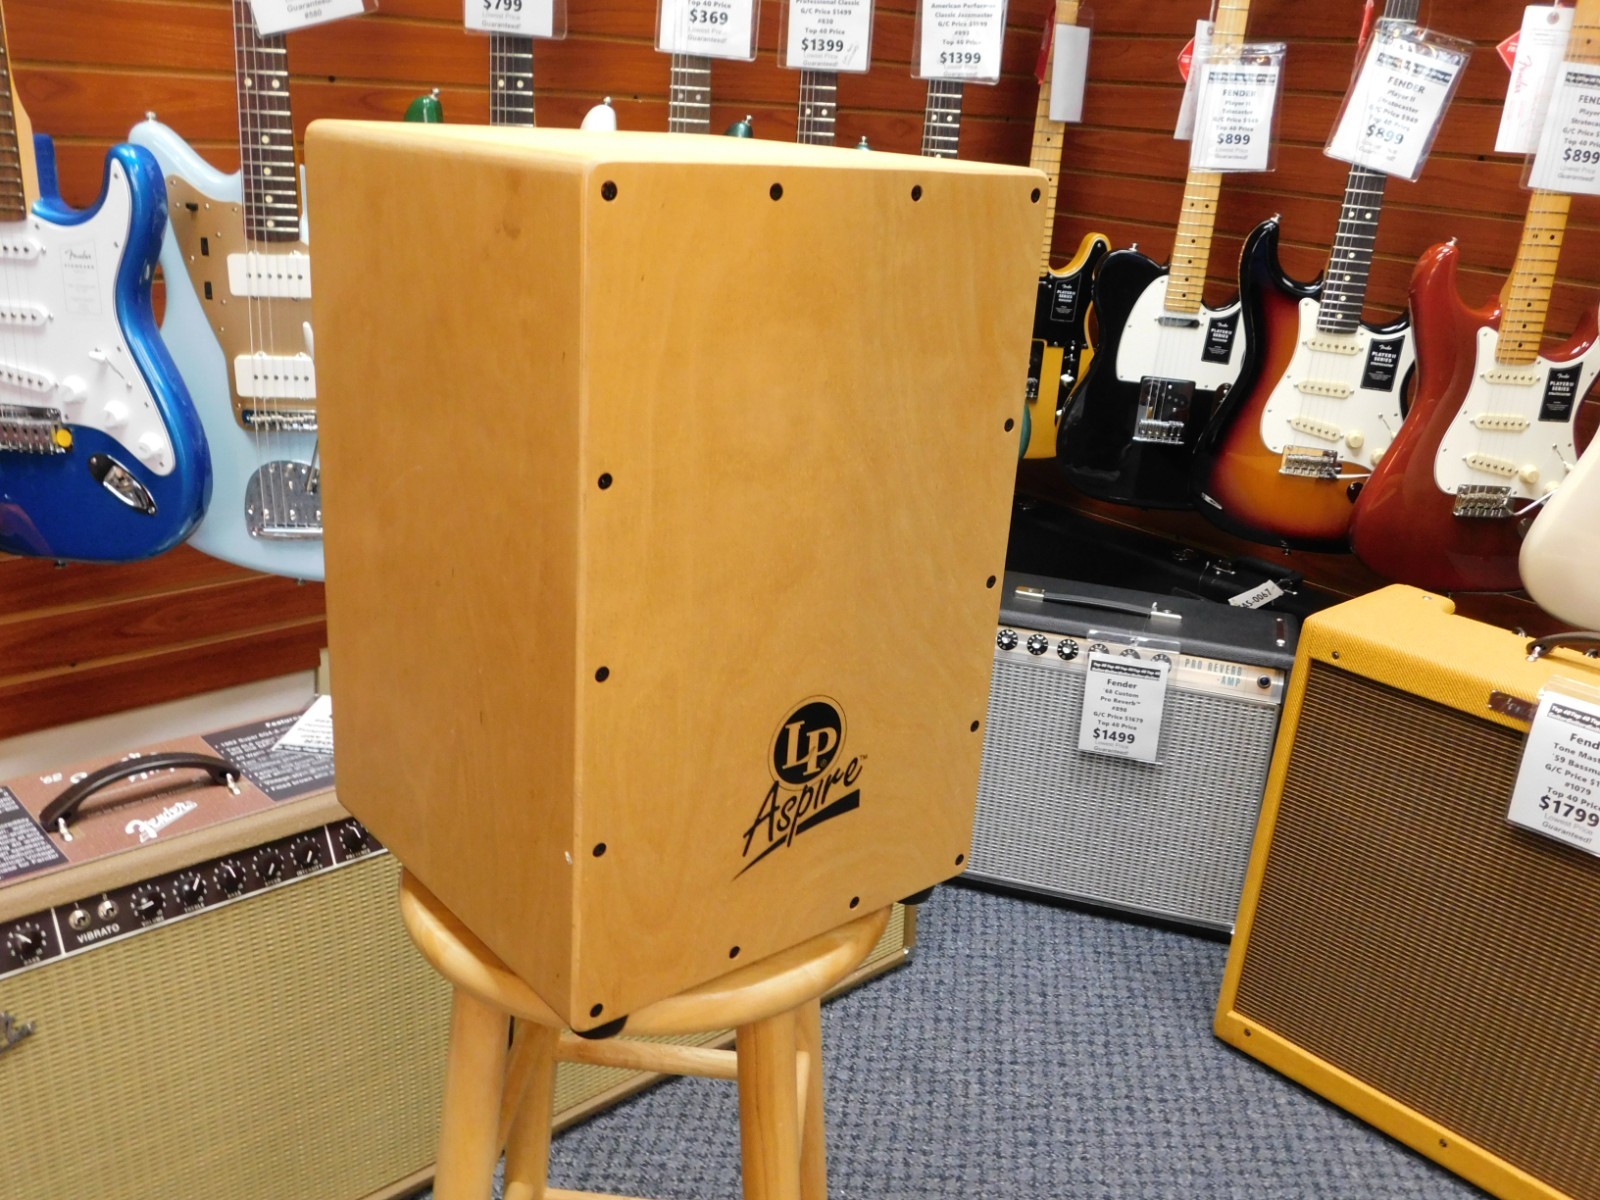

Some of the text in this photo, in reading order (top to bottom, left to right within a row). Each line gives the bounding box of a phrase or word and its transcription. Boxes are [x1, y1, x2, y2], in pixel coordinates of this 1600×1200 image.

[483, 0, 522, 11] $799
[689, 8, 728, 25] $369
[805, 27, 818, 35] Top
[801, 37, 844, 52] $1399
[940, 51, 982, 64] $1399
[1388, 76, 1426, 94] FENDER
[1217, 133, 1250, 145] $899
[1366, 123, 1404, 145] $899
[1577, 129, 1594, 137] Price
[1565, 137, 1577, 146] Top
[1563, 147, 1600, 164] $899
[1184, 658, 1243, 676] PRO REVERB
[1107, 678, 1138, 689] Fender
[1220, 676, 1241, 687] AMP
[1100, 695, 1111, 703] Pro
[1114, 690, 1139, 698] Custom
[1098, 719, 1110, 727] Top
[1093, 727, 1135, 744] $1499
[1554, 742, 1576, 755] Tone
[1544, 763, 1562, 775] G/C
[1564, 769, 1587, 783] Price
[1546, 786, 1564, 799] Top
[1566, 794, 1579, 803] 40
[1564, 782, 1592, 796] #1079
[1538, 794, 1600, 828] $1799
[126, 800, 198, 843] Fender
[77, 922, 120, 945] VIBRATO
